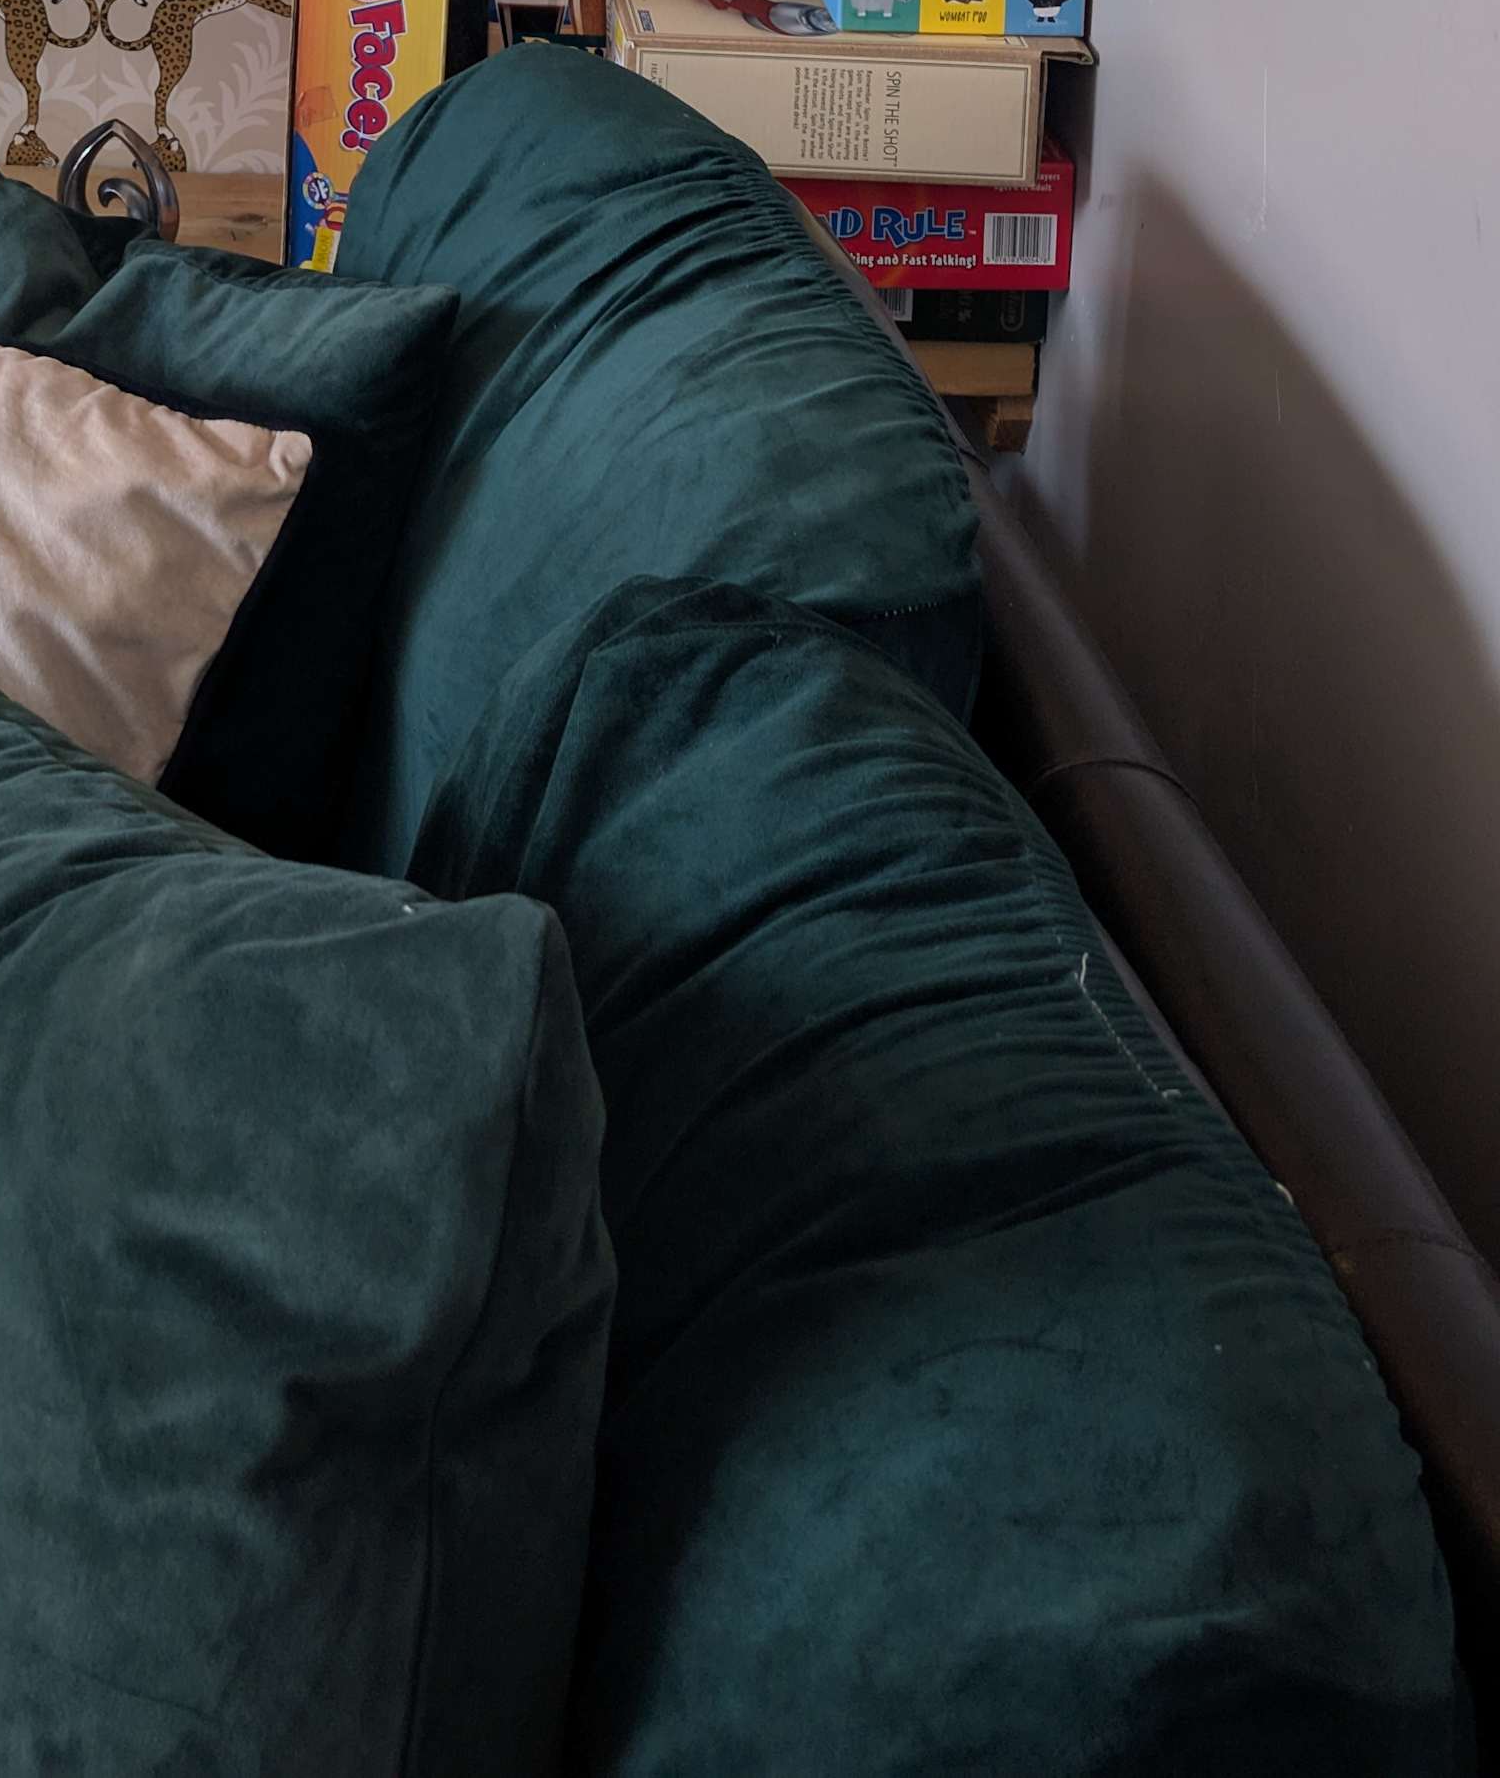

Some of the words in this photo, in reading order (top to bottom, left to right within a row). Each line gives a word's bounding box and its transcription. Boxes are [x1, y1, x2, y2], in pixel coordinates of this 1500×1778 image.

[939, 11, 970, 23] WOMBAT
[973, 11, 988, 23] POO
[886, 70, 901, 98] SPIN
[884, 101, 900, 125] THE
[883, 128, 898, 163] SHOT
[872, 206, 966, 249] RULE
[877, 253, 899, 266] and
[902, 254, 927, 266] Fast
[930, 254, 977, 269] Talking!
